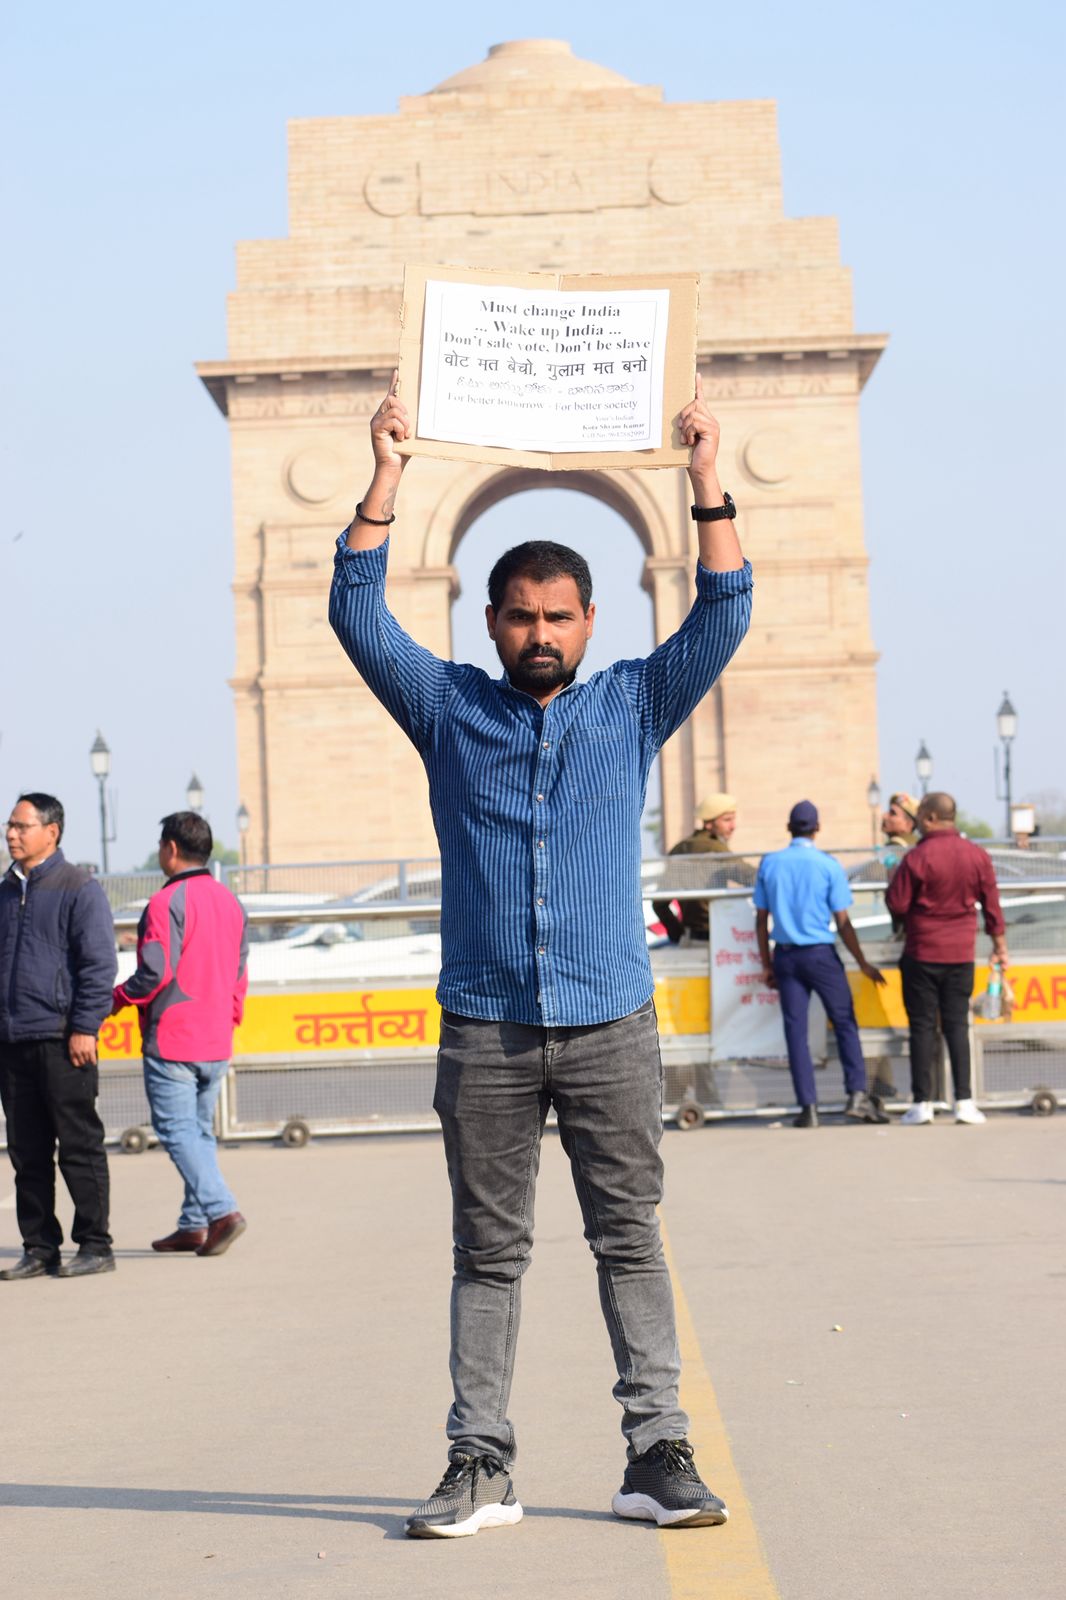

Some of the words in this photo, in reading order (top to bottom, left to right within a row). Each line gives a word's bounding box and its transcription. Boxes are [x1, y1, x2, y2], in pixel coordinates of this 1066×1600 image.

[480, 300, 518, 314] Must
[523, 303, 576, 321] change
[581, 305, 621, 318] India
[493, 320, 536, 337] Wake
[541, 327, 560, 341] up
[565, 325, 604, 338] India
[486, 338, 513, 350] sale
[596, 338, 612, 351] be
[616, 338, 651, 350] slave
[444, 350, 471, 368] वोट
[478, 357, 499, 372] मत
[507, 356, 537, 377] बेचो,
[546, 363, 585, 381] गुलाम
[593, 361, 614, 375] मत
[622, 354, 648, 373] बनो
[448, 391, 464, 403] For
[467, 394, 496, 406] better
[497, 397, 545, 409] tomorrow
[555, 402, 572, 413] For
[574, 401, 602, 412] better
[604, 398, 639, 413] society
